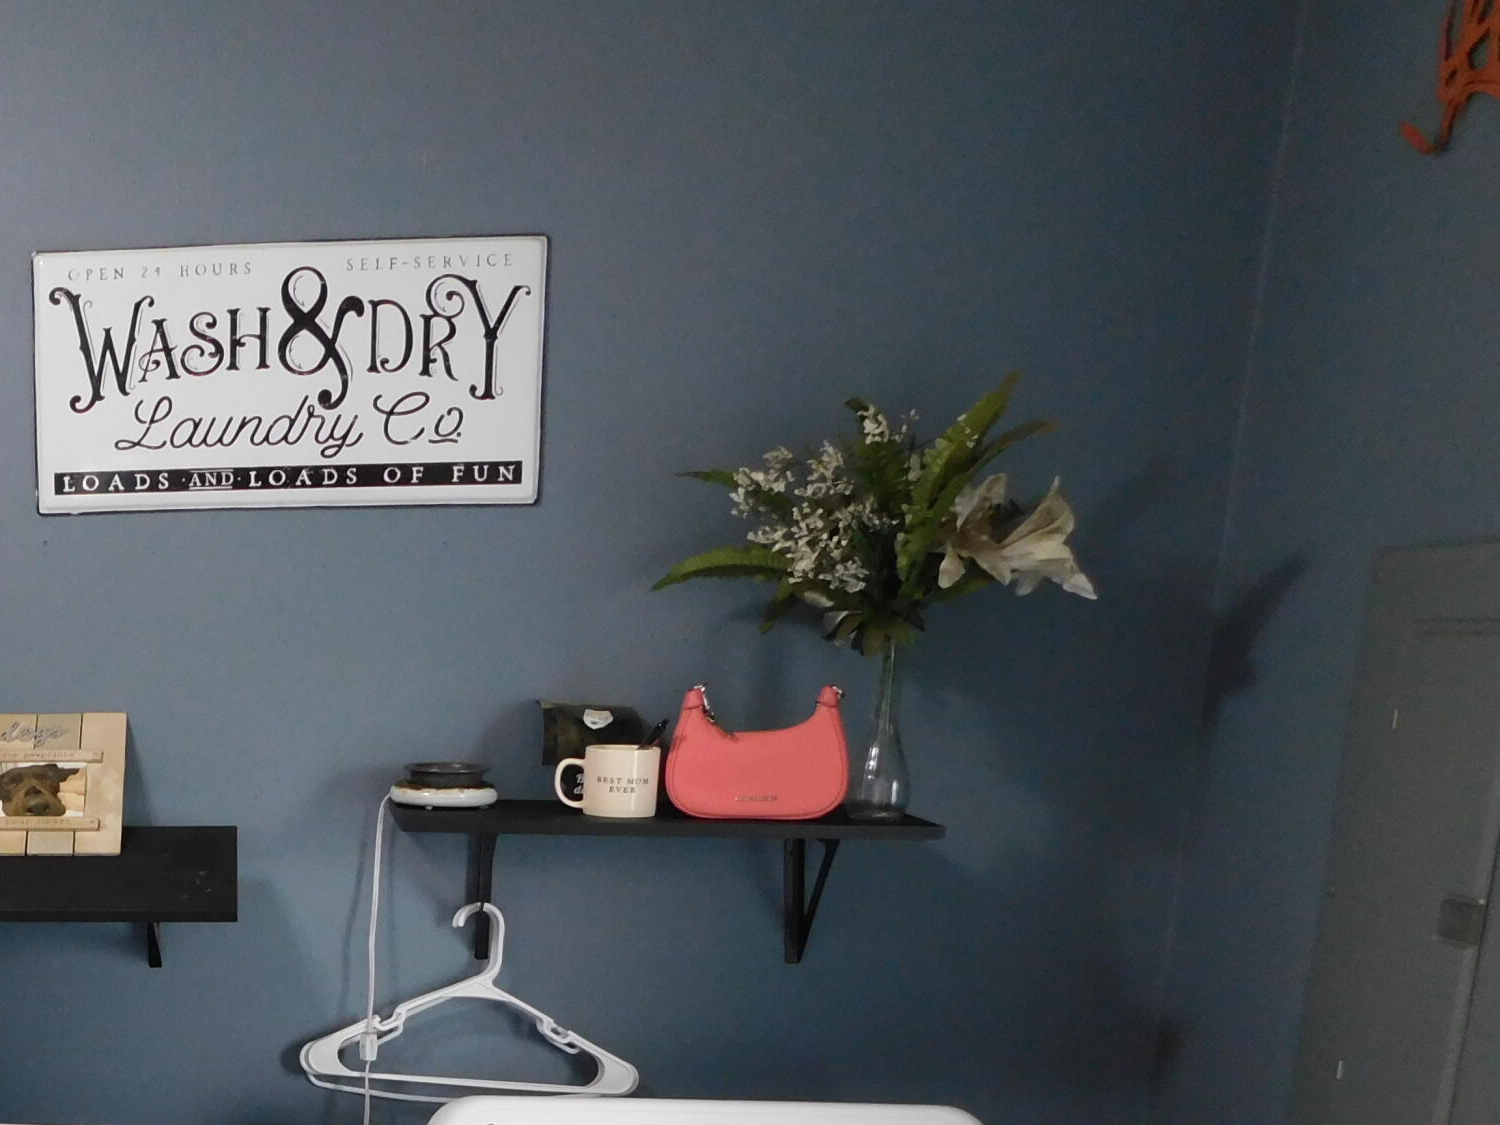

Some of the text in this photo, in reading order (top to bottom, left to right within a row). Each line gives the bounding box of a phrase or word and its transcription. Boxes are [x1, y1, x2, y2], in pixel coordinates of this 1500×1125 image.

[67, 261, 252, 281] OPEN 24 HOURS
[345, 252, 514, 272] SELF-SERVICE
[48, 265, 532, 414] WASH & DRY
[114, 394, 364, 459] Laundry
[62, 472, 170, 493] LOADS
[249, 465, 358, 488] LOADS
[383, 466, 424, 484] OF
[451, 464, 517, 483] FUN
[596, 776, 650, 786] BEST MOM
[608, 785, 636, 794] EVER
